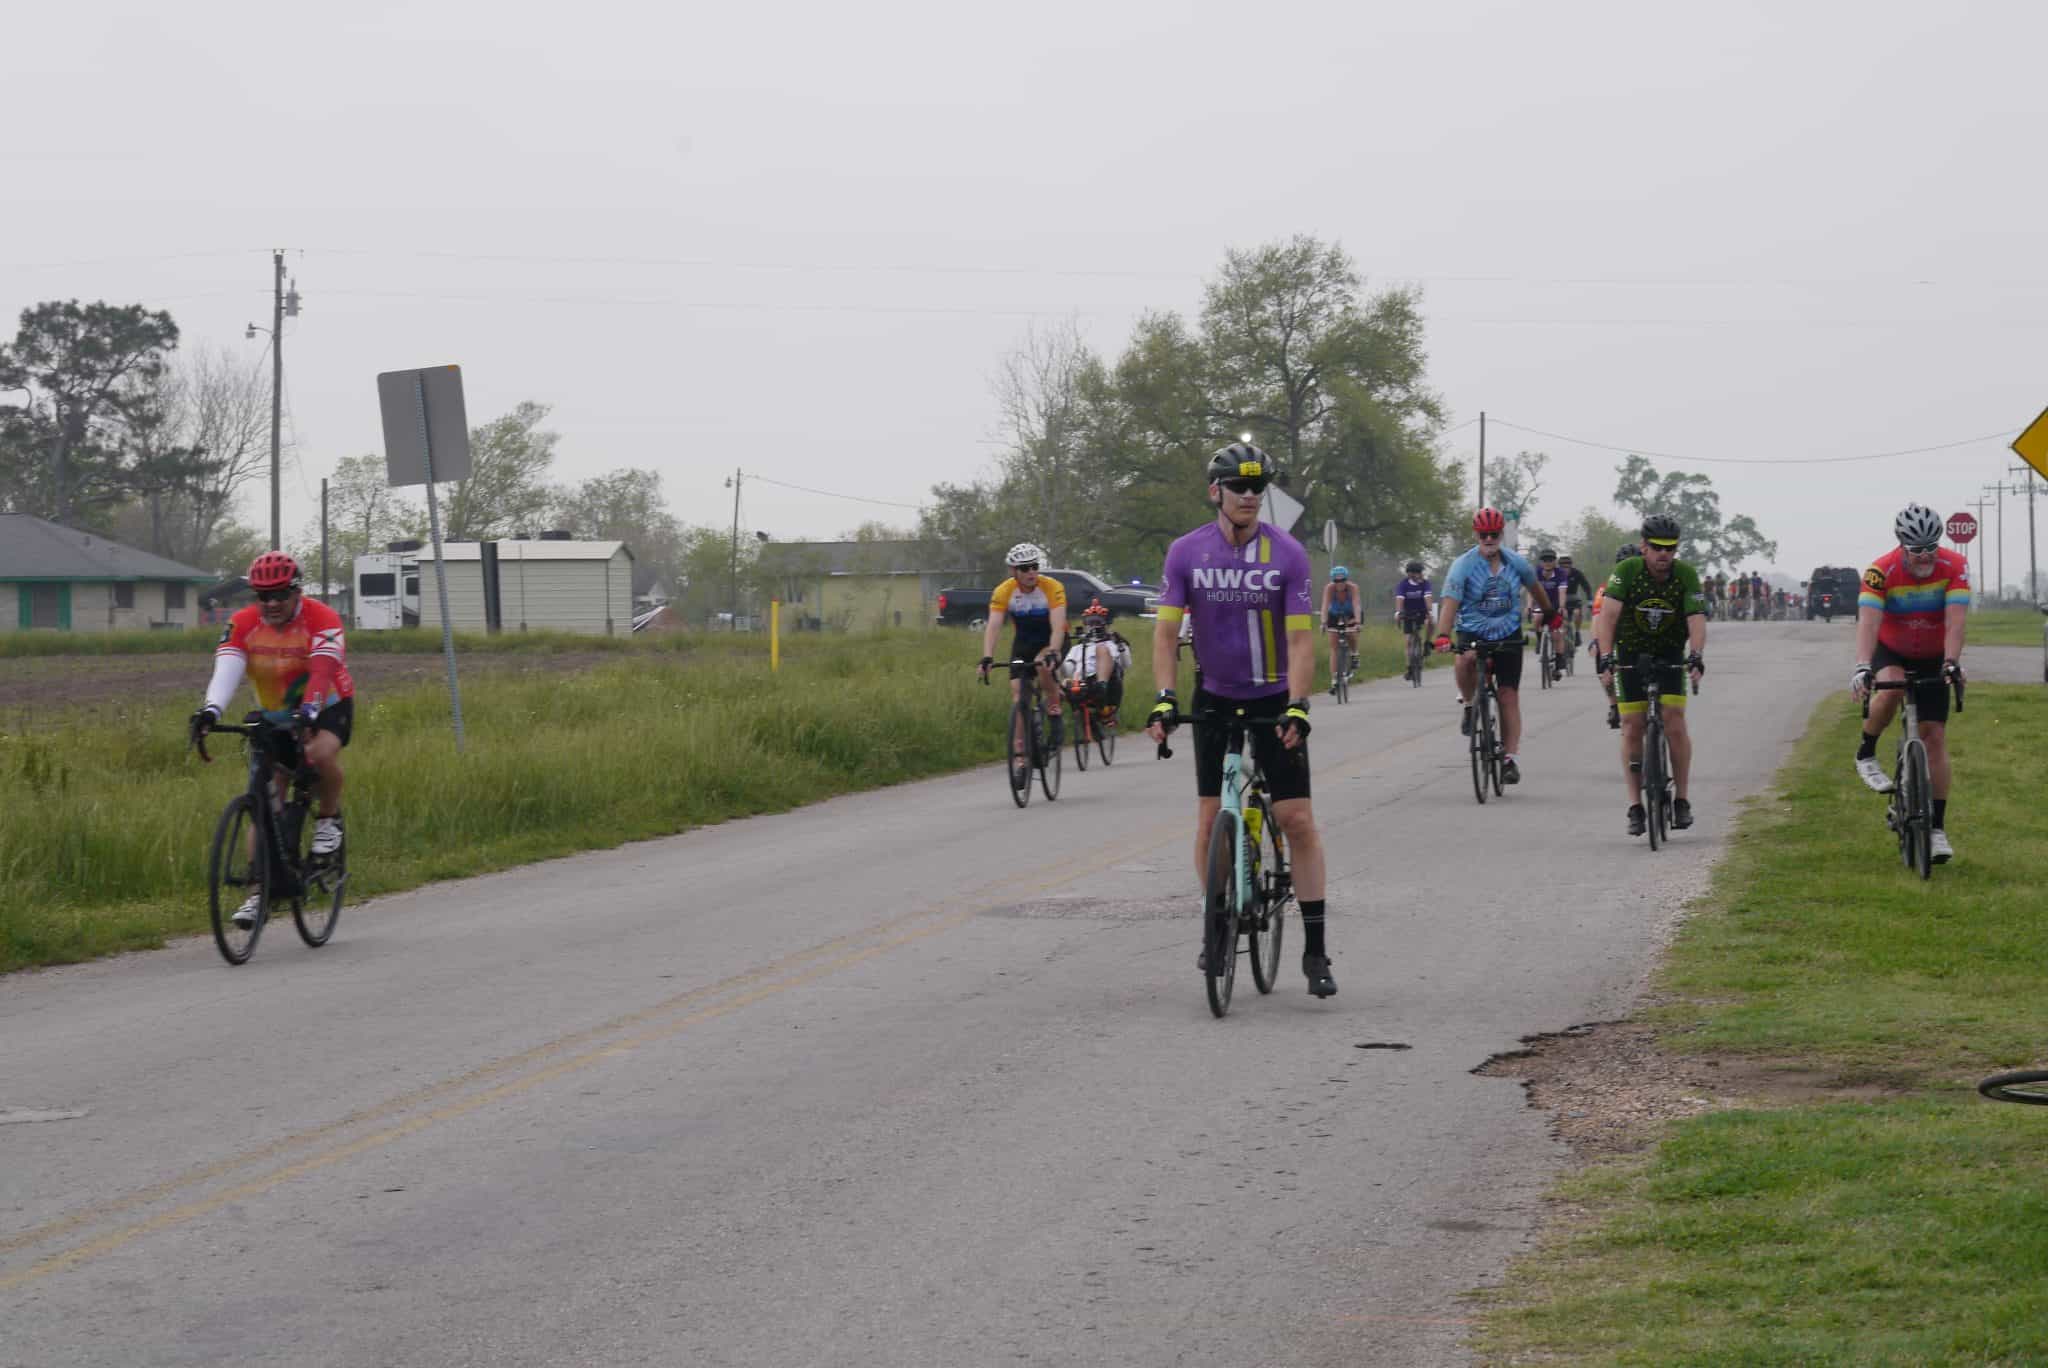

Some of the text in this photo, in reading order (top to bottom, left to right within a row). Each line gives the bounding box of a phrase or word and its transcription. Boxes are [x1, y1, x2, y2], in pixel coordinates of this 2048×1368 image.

[1947, 522, 1977, 535] STOP
[1192, 568, 1281, 591] NWCC
[1207, 591, 1268, 603] HOUSTON
